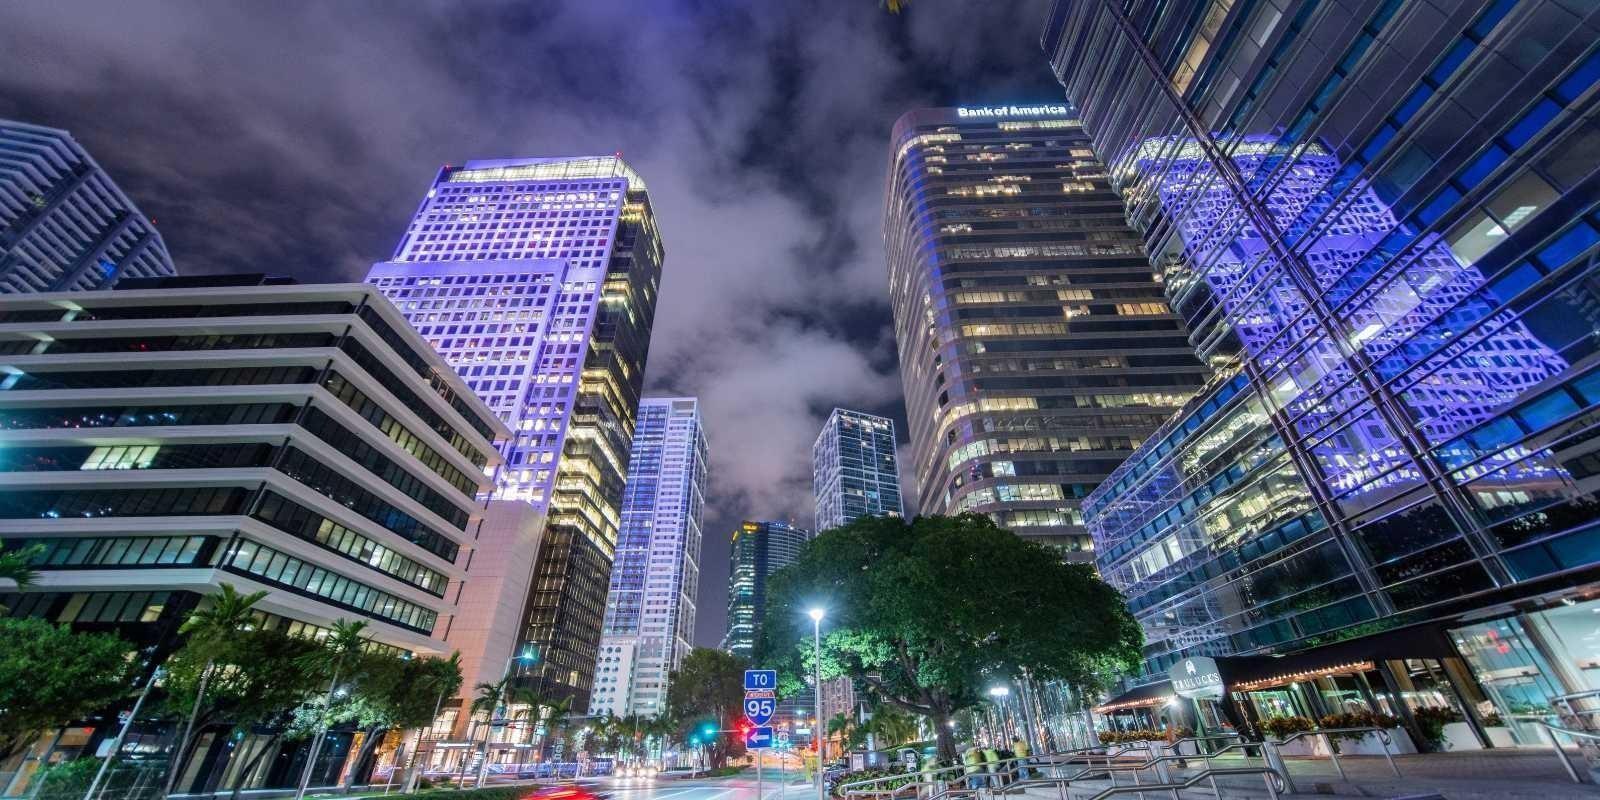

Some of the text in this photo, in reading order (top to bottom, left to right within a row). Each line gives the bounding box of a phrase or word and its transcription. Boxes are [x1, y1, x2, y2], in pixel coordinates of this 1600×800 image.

[958, 104, 1067, 117] Bank of America
[752, 673, 768, 686] TO
[747, 700, 772, 717] 95
